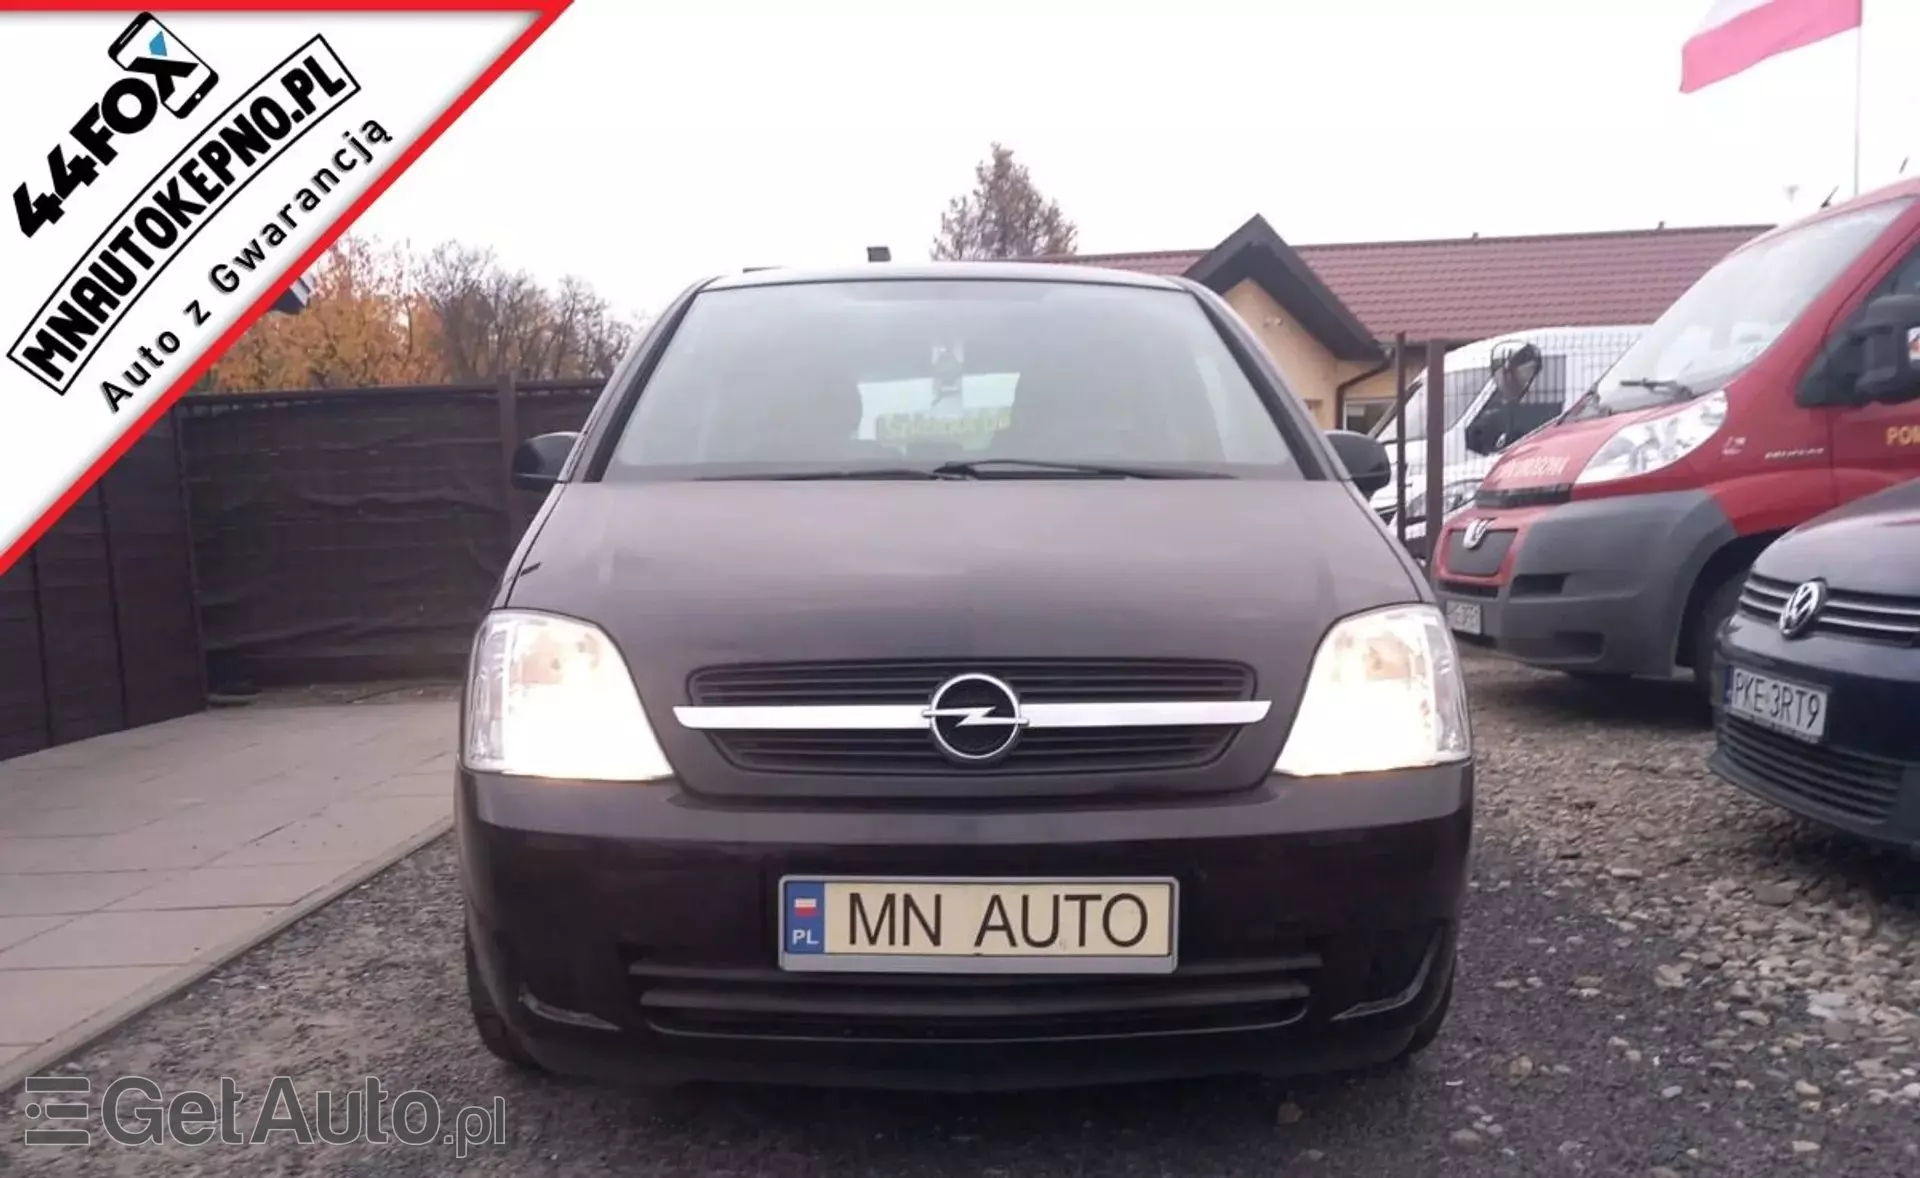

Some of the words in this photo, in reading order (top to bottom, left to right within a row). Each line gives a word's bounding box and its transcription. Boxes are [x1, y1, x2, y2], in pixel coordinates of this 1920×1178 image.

[1734, 672, 1766, 714] PKE
[1769, 683, 1821, 730] 3RT9
[792, 929, 819, 945] PL
[848, 892, 942, 947] MN
[973, 893, 1149, 948] AUTO
